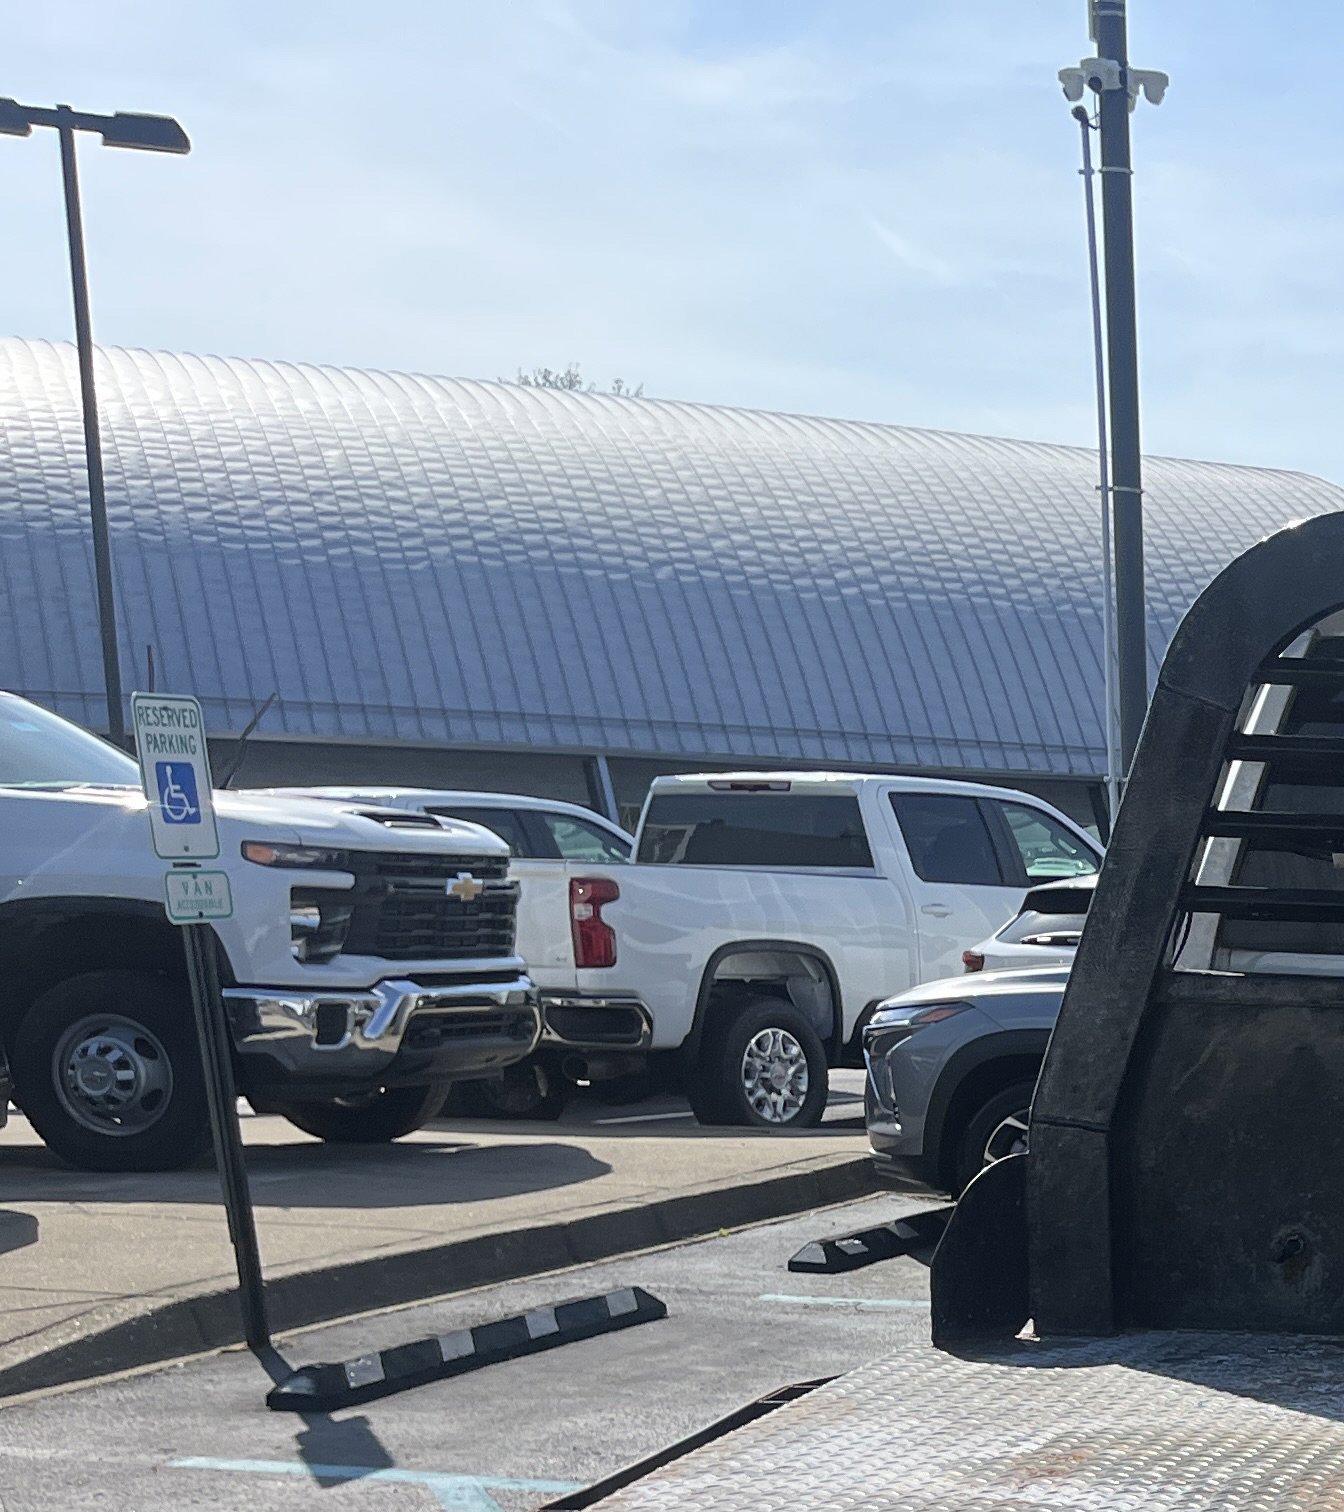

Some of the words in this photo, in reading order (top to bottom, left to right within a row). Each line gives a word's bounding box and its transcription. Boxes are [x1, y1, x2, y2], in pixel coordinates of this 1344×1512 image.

[137, 706, 198, 728] RESERVED
[145, 733, 197, 755] PARKING
[182, 881, 213, 896] VAN
